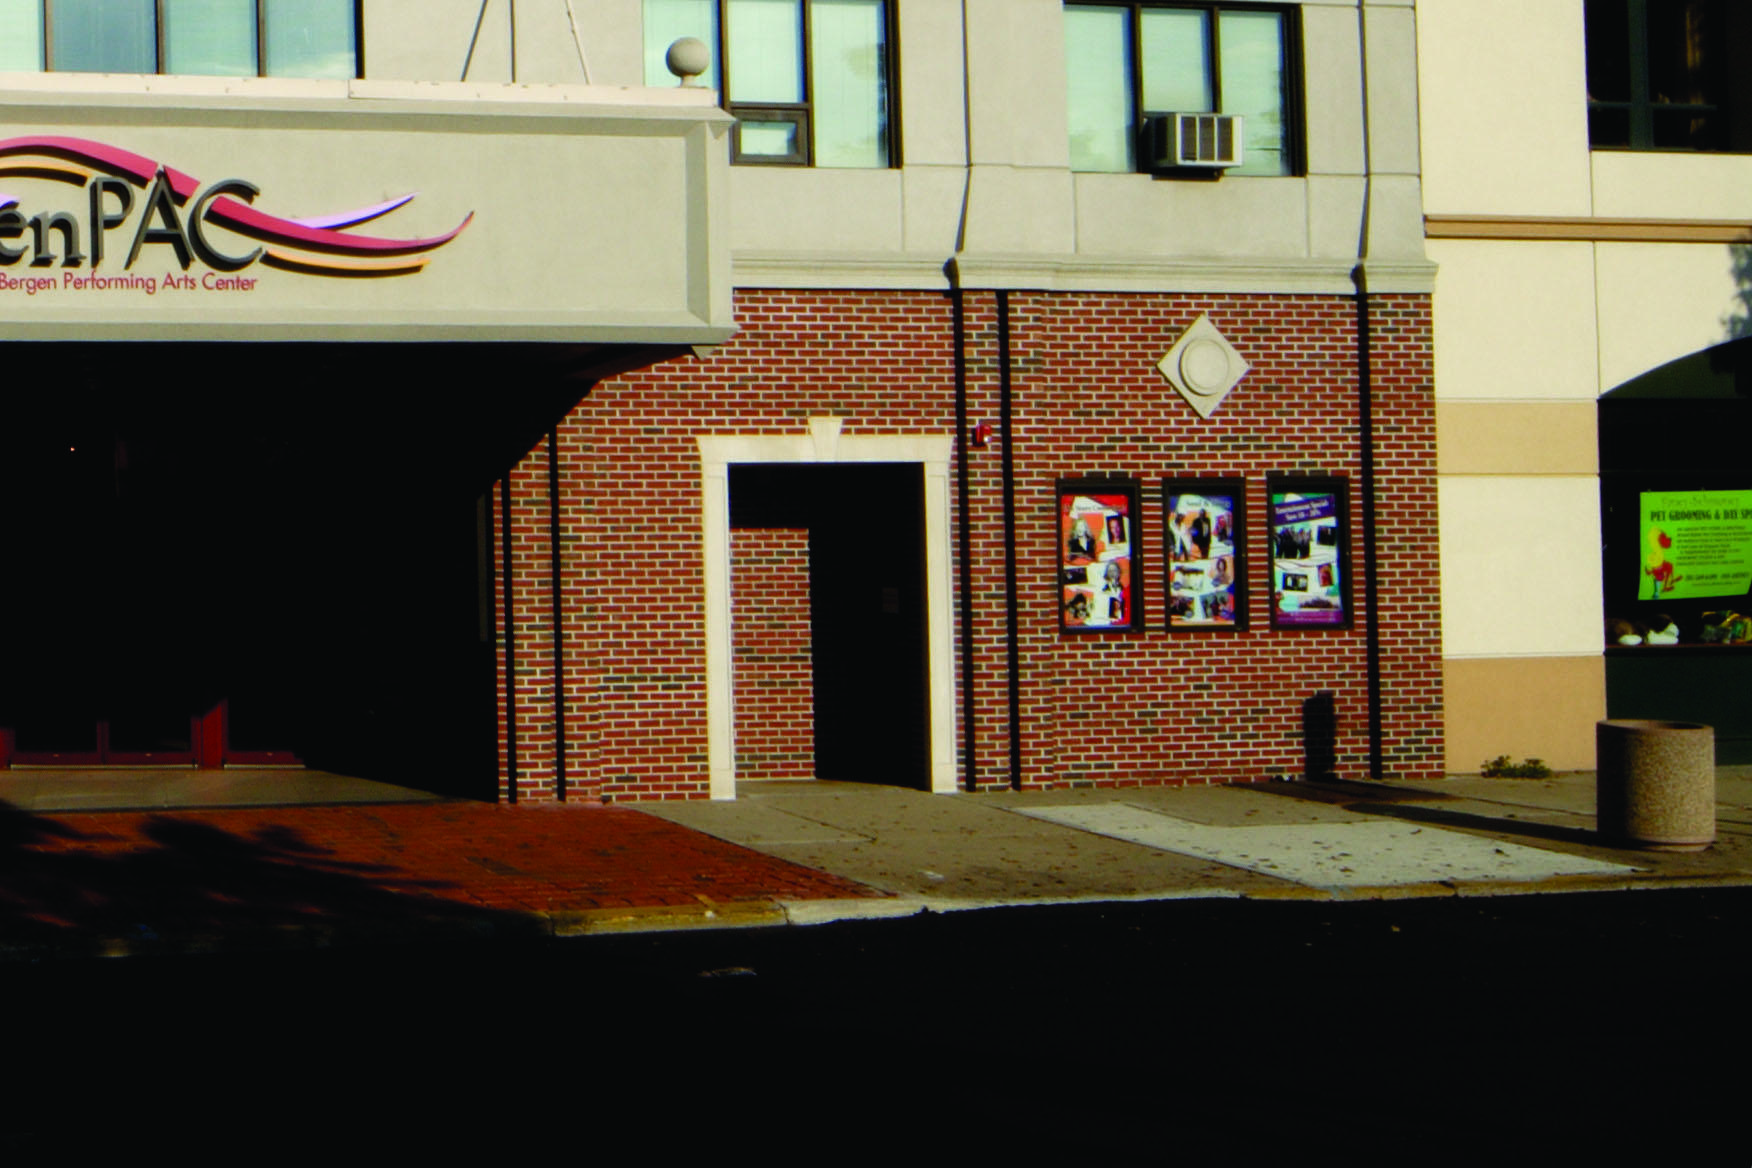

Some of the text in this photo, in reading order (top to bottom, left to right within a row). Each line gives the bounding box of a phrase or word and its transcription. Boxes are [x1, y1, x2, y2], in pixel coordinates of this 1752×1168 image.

[63, 270, 157, 295] Performing
[162, 272, 197, 291] Arts
[202, 272, 258, 292] Center
[1650, 510, 1666, 522] PET
[1668, 509, 1712, 521] GROOMING
